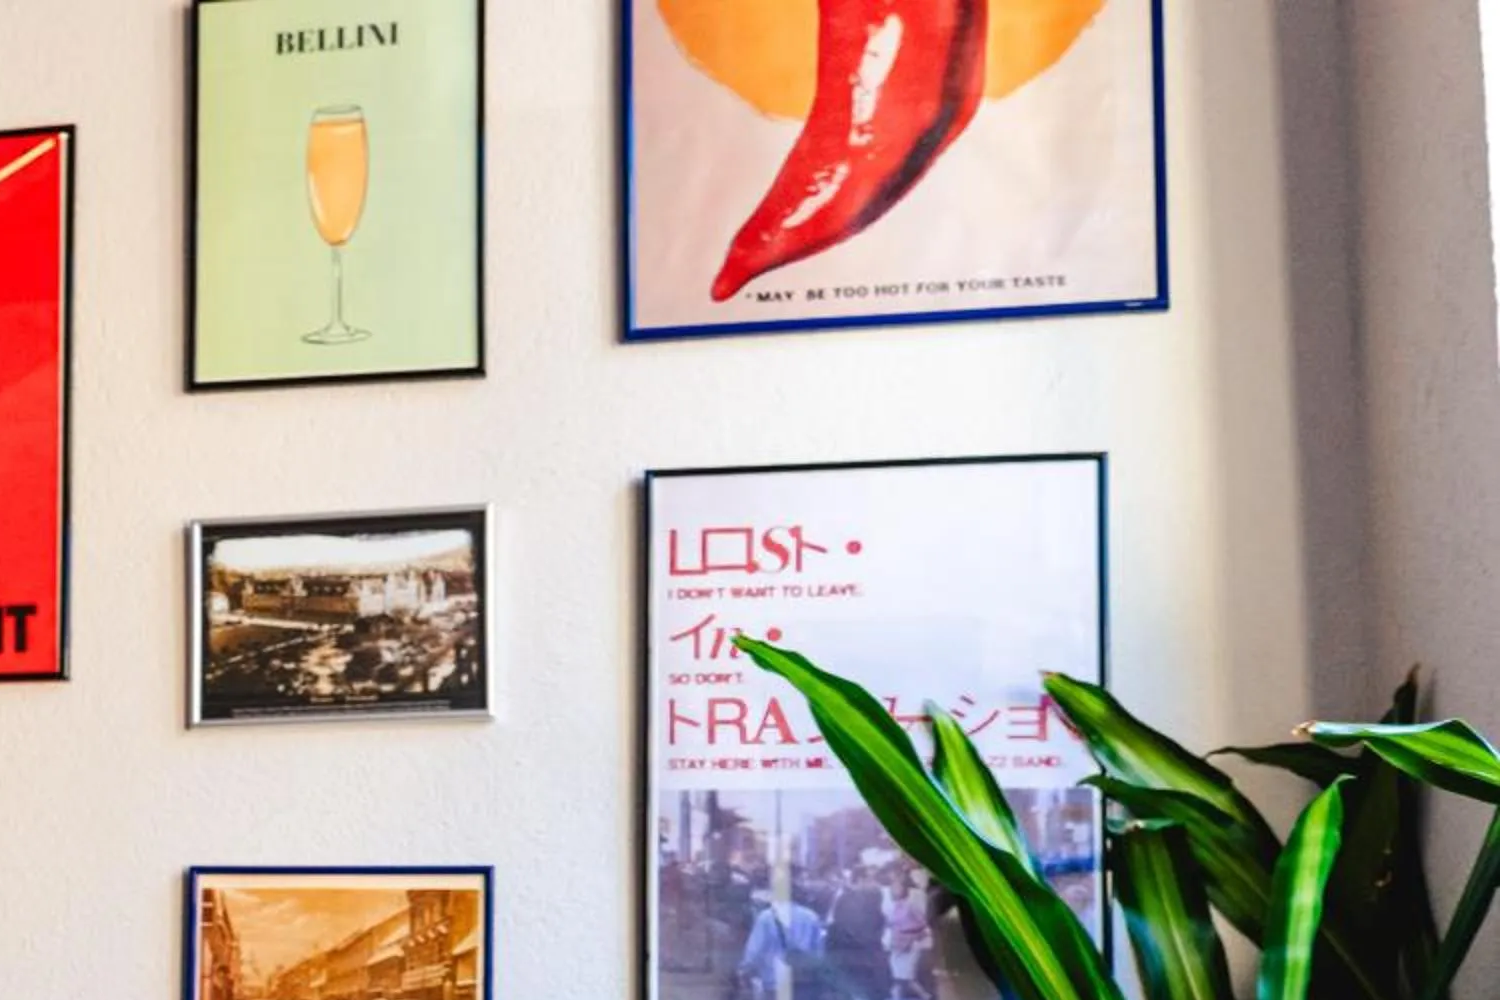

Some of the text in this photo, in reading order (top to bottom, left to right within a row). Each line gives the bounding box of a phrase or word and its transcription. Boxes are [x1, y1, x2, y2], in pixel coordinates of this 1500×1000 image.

[275, 22, 398, 55] BELLINI
[806, 288, 825, 300] BE
[833, 285, 869, 298] TOO
[874, 283, 910, 297] HOT
[915, 281, 950, 294] FOR
[956, 278, 1006, 291] YOUR
[1012, 275, 1067, 288] TASTE
[677, 587, 725, 600] DON'T
[729, 586, 776, 599] WANT
[781, 585, 804, 598] TO
[668, 673, 690, 685] SO
[668, 757, 706, 770] STAY
[711, 757, 752, 770] HERE
